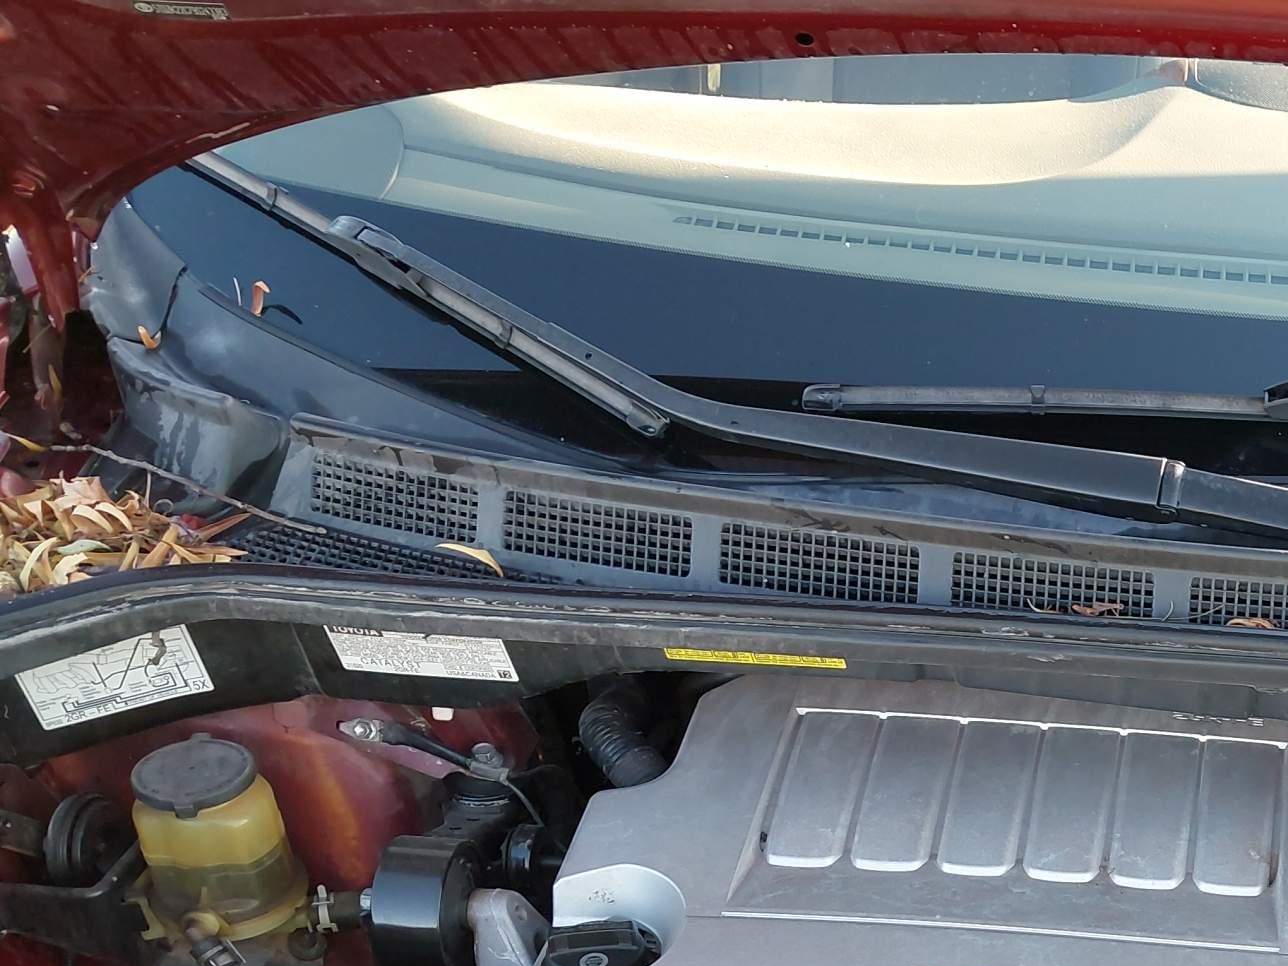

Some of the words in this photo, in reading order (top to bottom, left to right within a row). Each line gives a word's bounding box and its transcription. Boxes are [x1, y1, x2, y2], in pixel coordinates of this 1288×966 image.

[332, 625, 380, 636] TOYOTA
[360, 656, 420, 668] CATALYST
[191, 680, 209, 691] 5X
